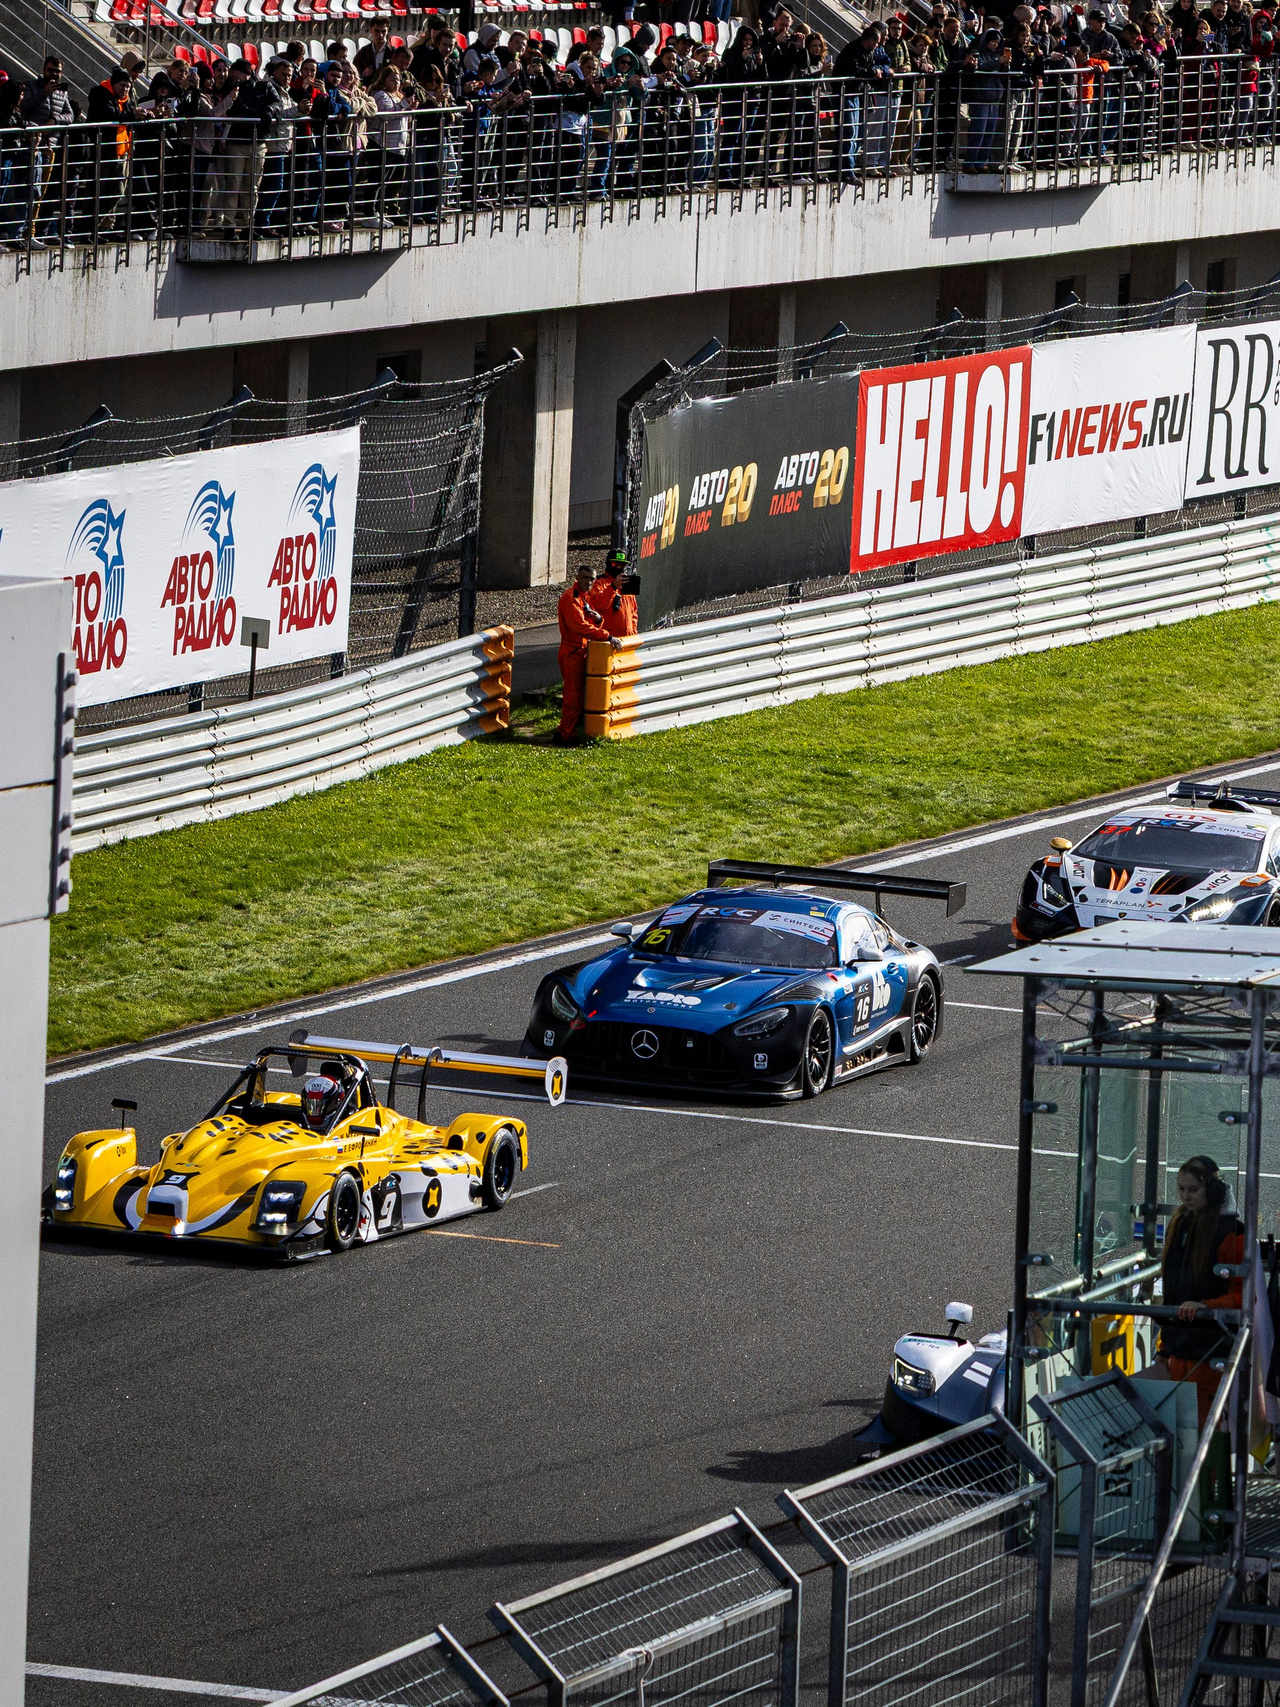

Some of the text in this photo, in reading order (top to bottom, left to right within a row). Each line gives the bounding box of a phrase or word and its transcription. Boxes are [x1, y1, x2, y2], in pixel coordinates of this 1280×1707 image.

[1028, 392, 1190, 465] F1NEWS.RU
[1196, 333, 1274, 485] RR
[774, 446, 849, 508] АВТО 20
[859, 362, 1023, 556] HELLO!
[643, 484, 680, 550] АВТО 20
[688, 462, 758, 527] АВТО 20
[769, 490, 803, 516] ПЛЮС
[684, 509, 712, 537] ПЛЮС
[160, 550, 213, 608] АВТО
[267, 532, 316, 588] АВТО
[62, 571, 101, 625] ТО
[278, 576, 337, 635] РАДИО
[73, 617, 127, 675] АДИО
[173, 596, 236, 656] РАДИО
[1164, 813, 1217, 822] GTS
[783, 917, 826, 934] СИНТЕРА
[1095, 898, 1146, 908] TERAPLAN
[643, 928, 672, 945] 16
[624, 999, 694, 1009] MOTORSPORT
[856, 996, 870, 1022] 16
[165, 1175, 187, 1184] 9
[378, 1192, 396, 1229] 9
